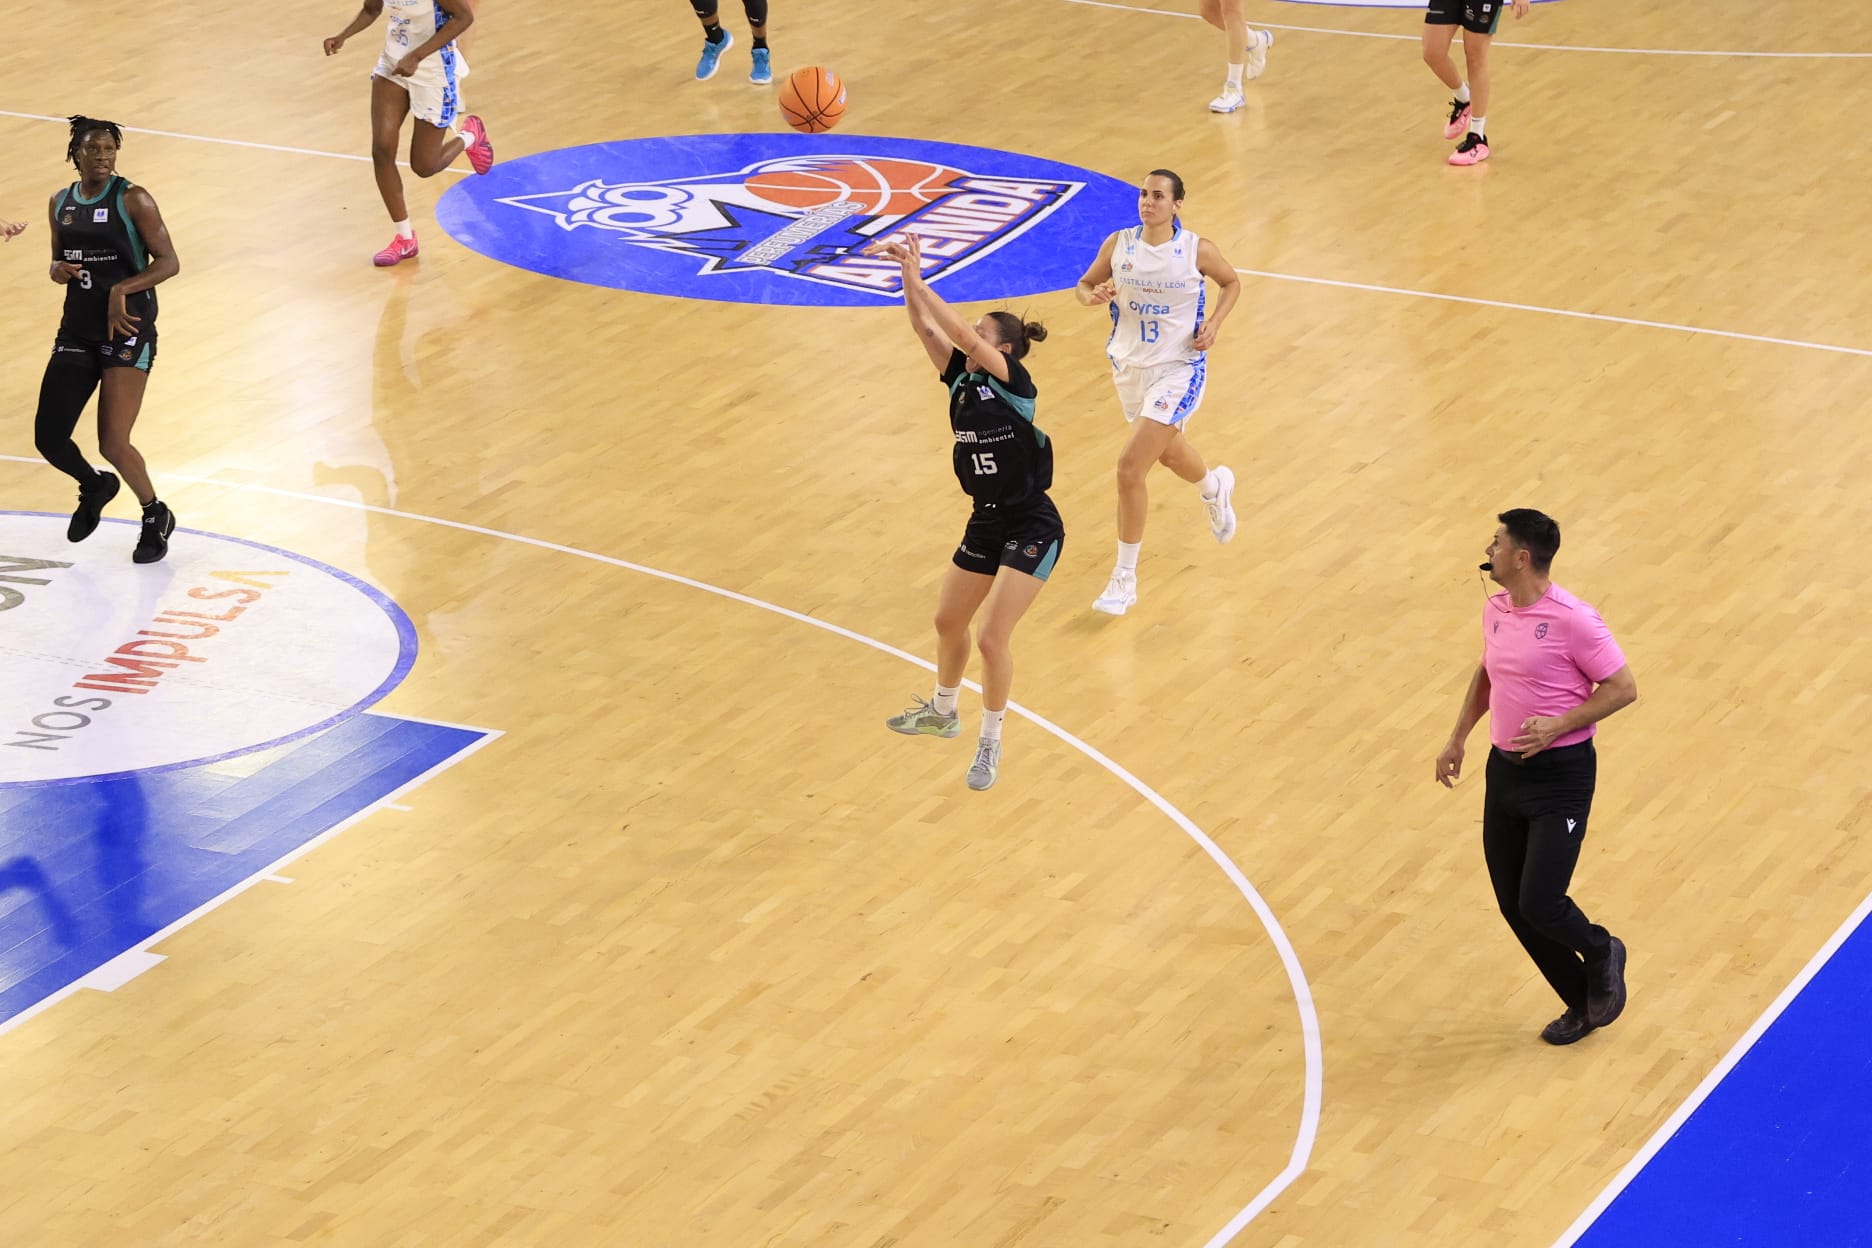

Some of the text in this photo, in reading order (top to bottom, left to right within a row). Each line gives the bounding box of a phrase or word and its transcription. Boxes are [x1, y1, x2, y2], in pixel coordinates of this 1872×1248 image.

[1140, 320, 1159, 343] 13
[979, 431, 1015, 444] ambiental
[971, 452, 998, 475] 15
[5, 695, 113, 751] NOS
